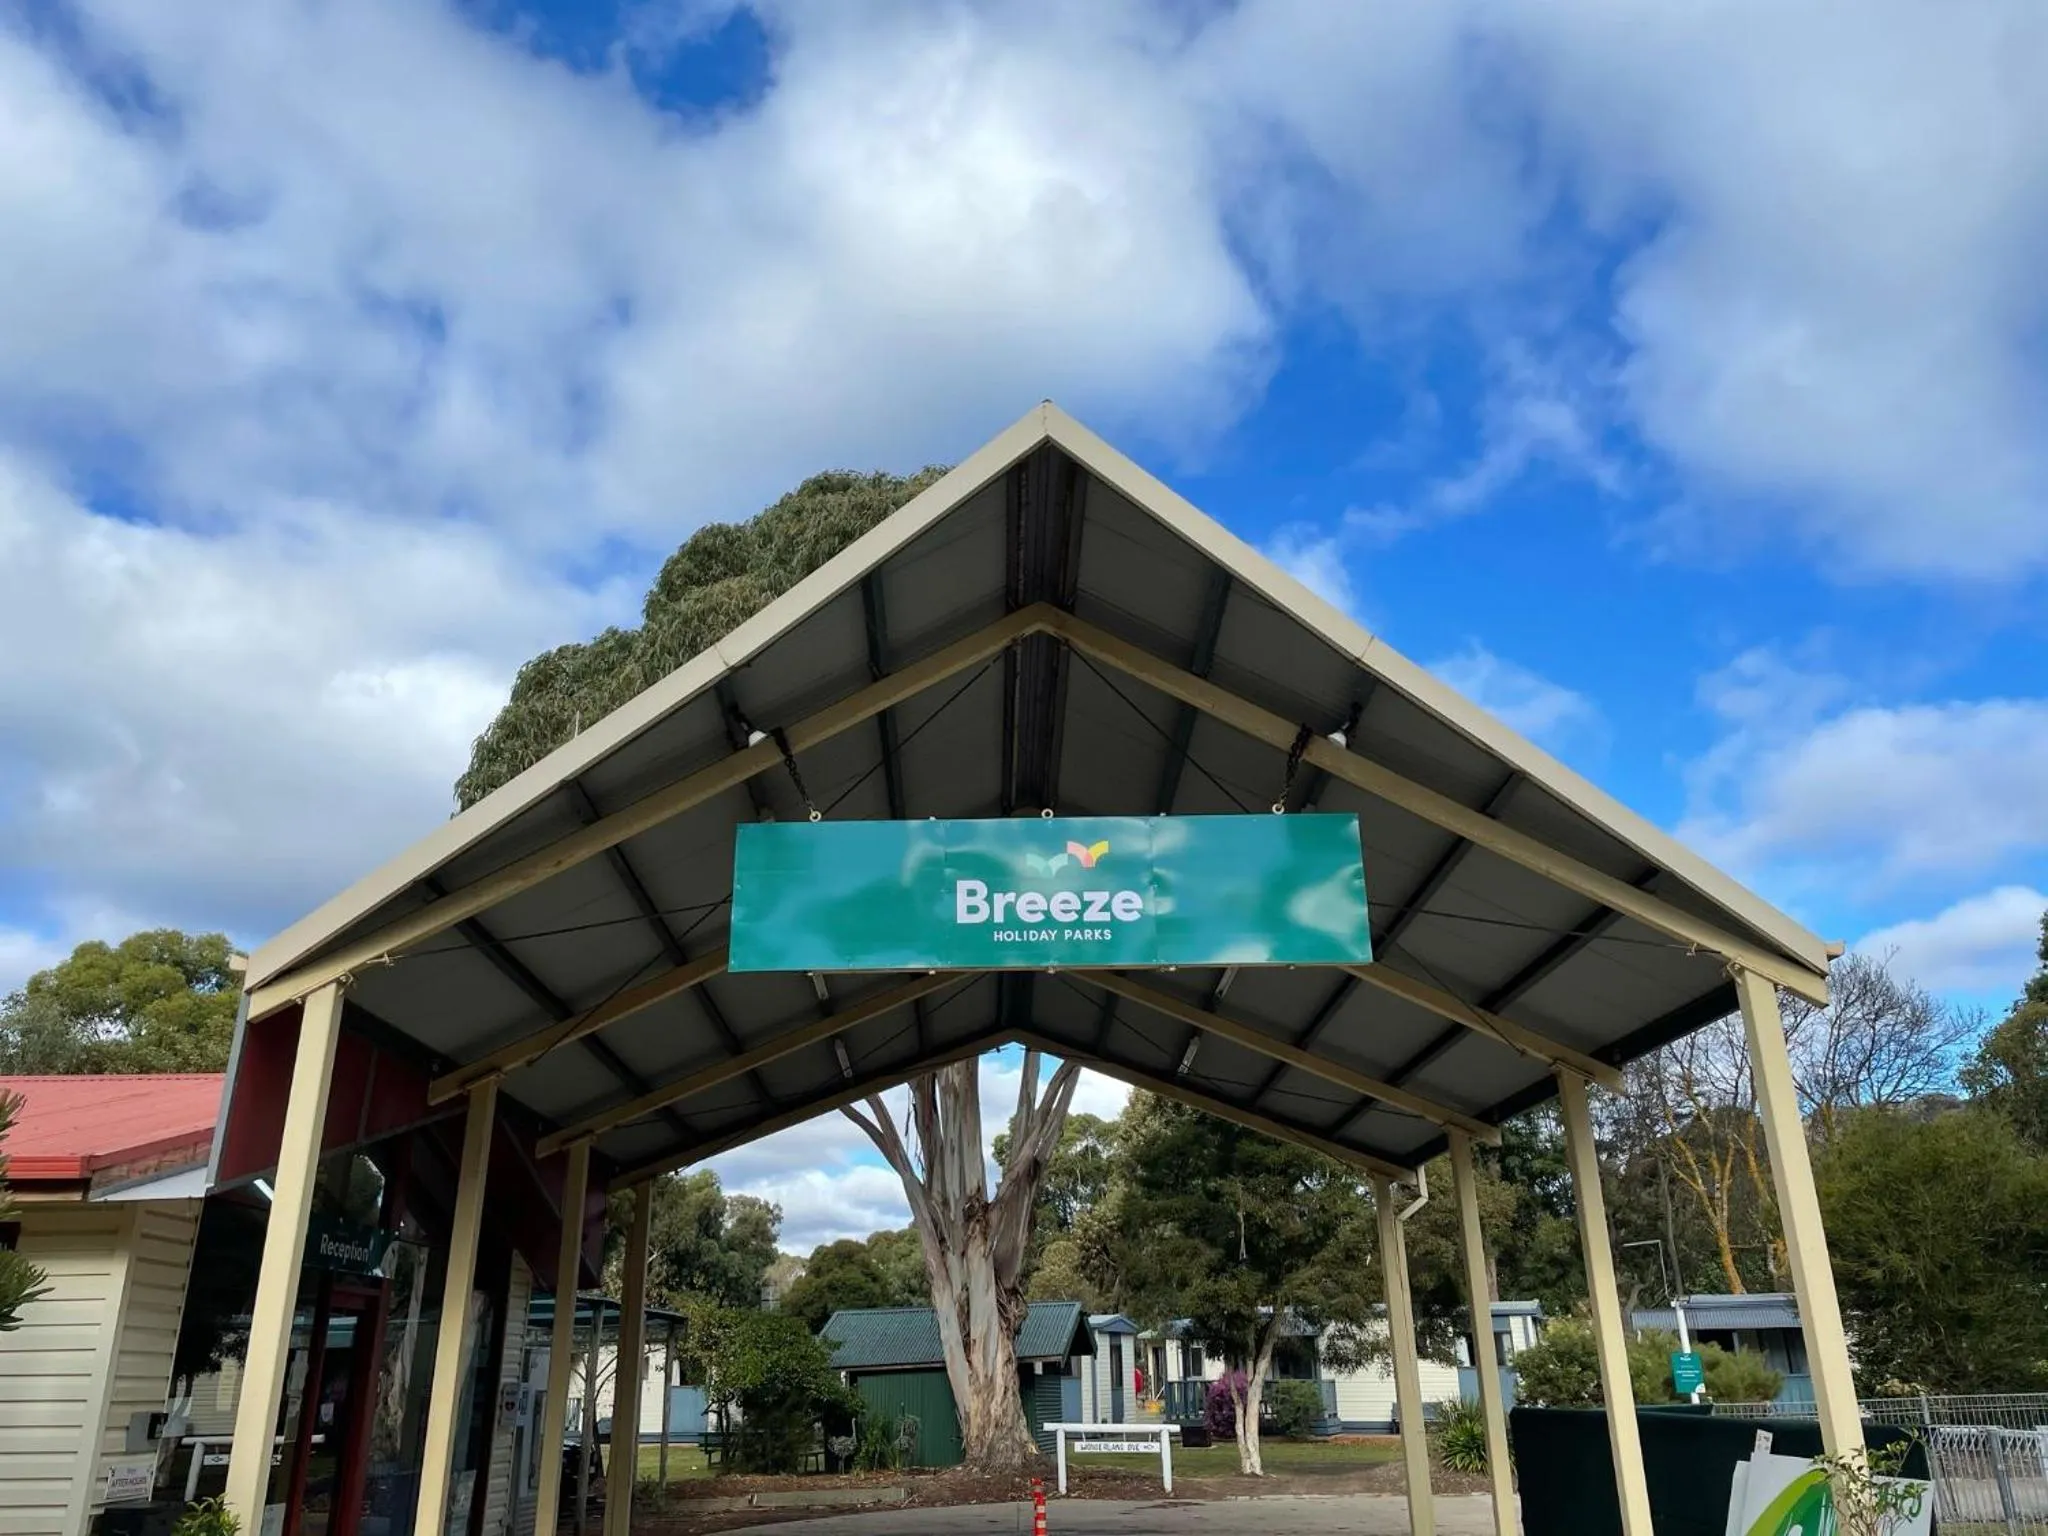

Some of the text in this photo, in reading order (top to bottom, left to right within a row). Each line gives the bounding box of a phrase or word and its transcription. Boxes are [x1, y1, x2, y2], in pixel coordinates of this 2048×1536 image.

[956, 880, 1144, 923] Breeze
[993, 929, 1112, 942] HOLIDAY PARKS
[320, 1233, 370, 1265] Reception
